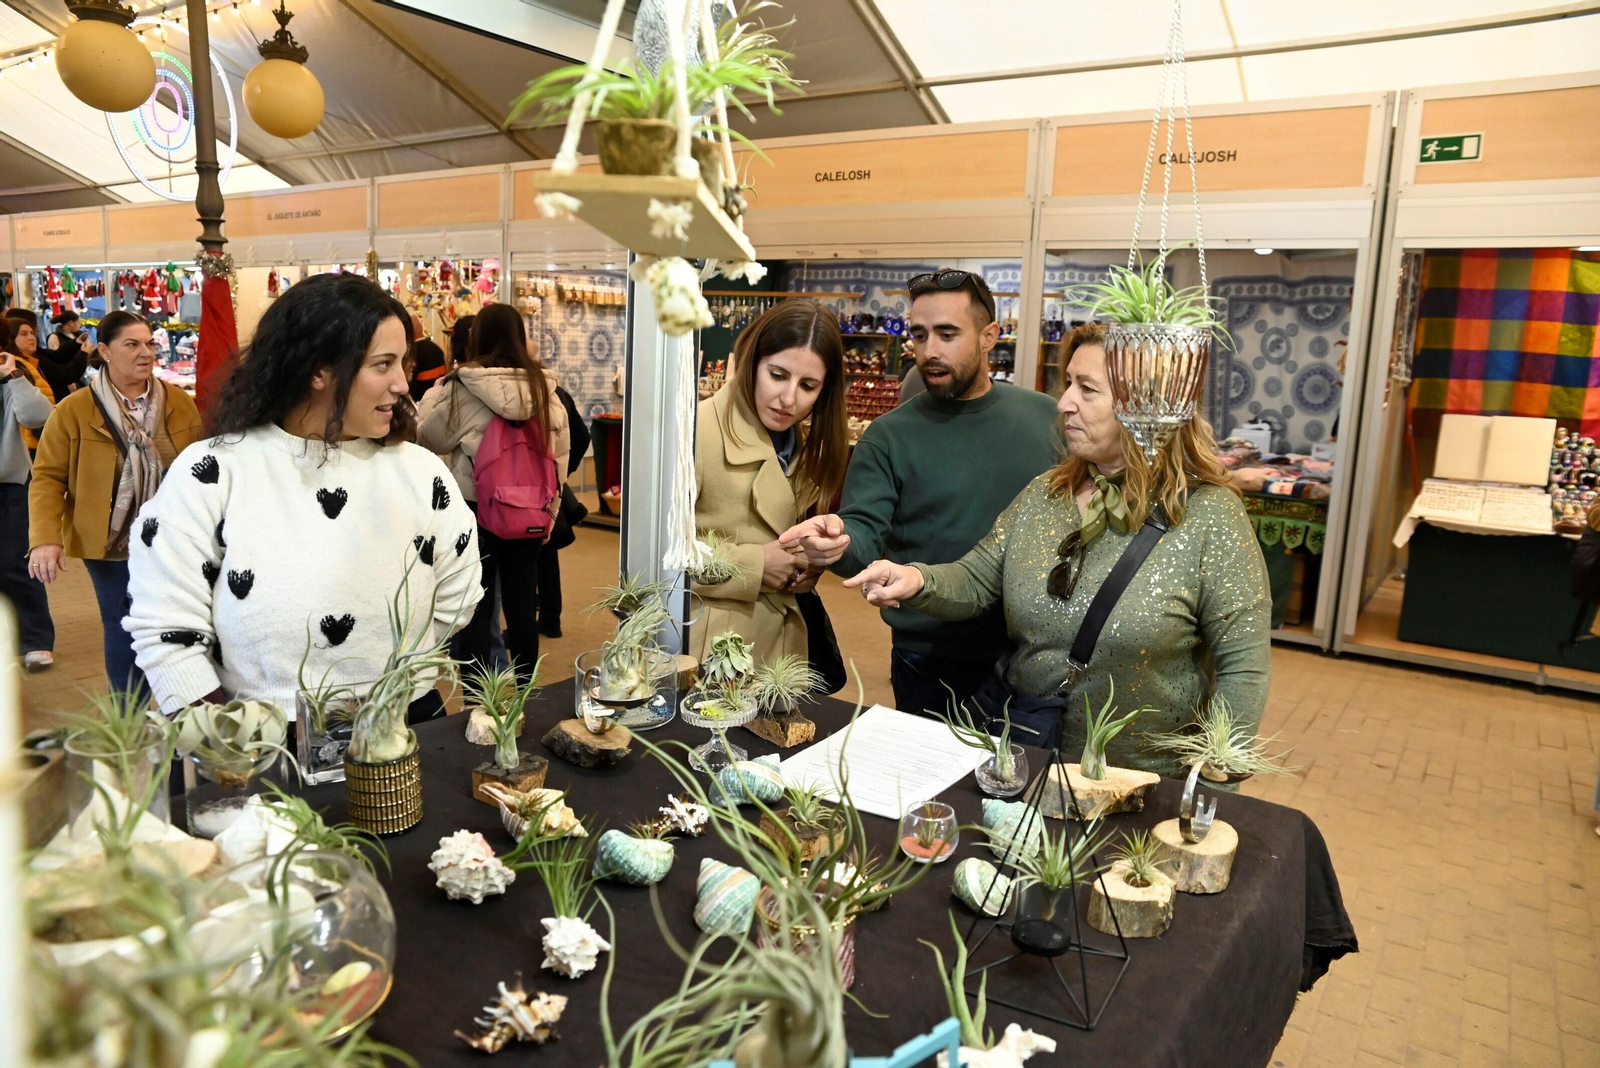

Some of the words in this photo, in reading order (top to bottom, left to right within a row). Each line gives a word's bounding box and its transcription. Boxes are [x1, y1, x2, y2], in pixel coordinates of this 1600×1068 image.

[815, 170, 871, 182] CALELOSH
[267, 213, 273, 221] EL
[274, 211, 294, 220] JUGUETE
[295, 211, 301, 219] DE
